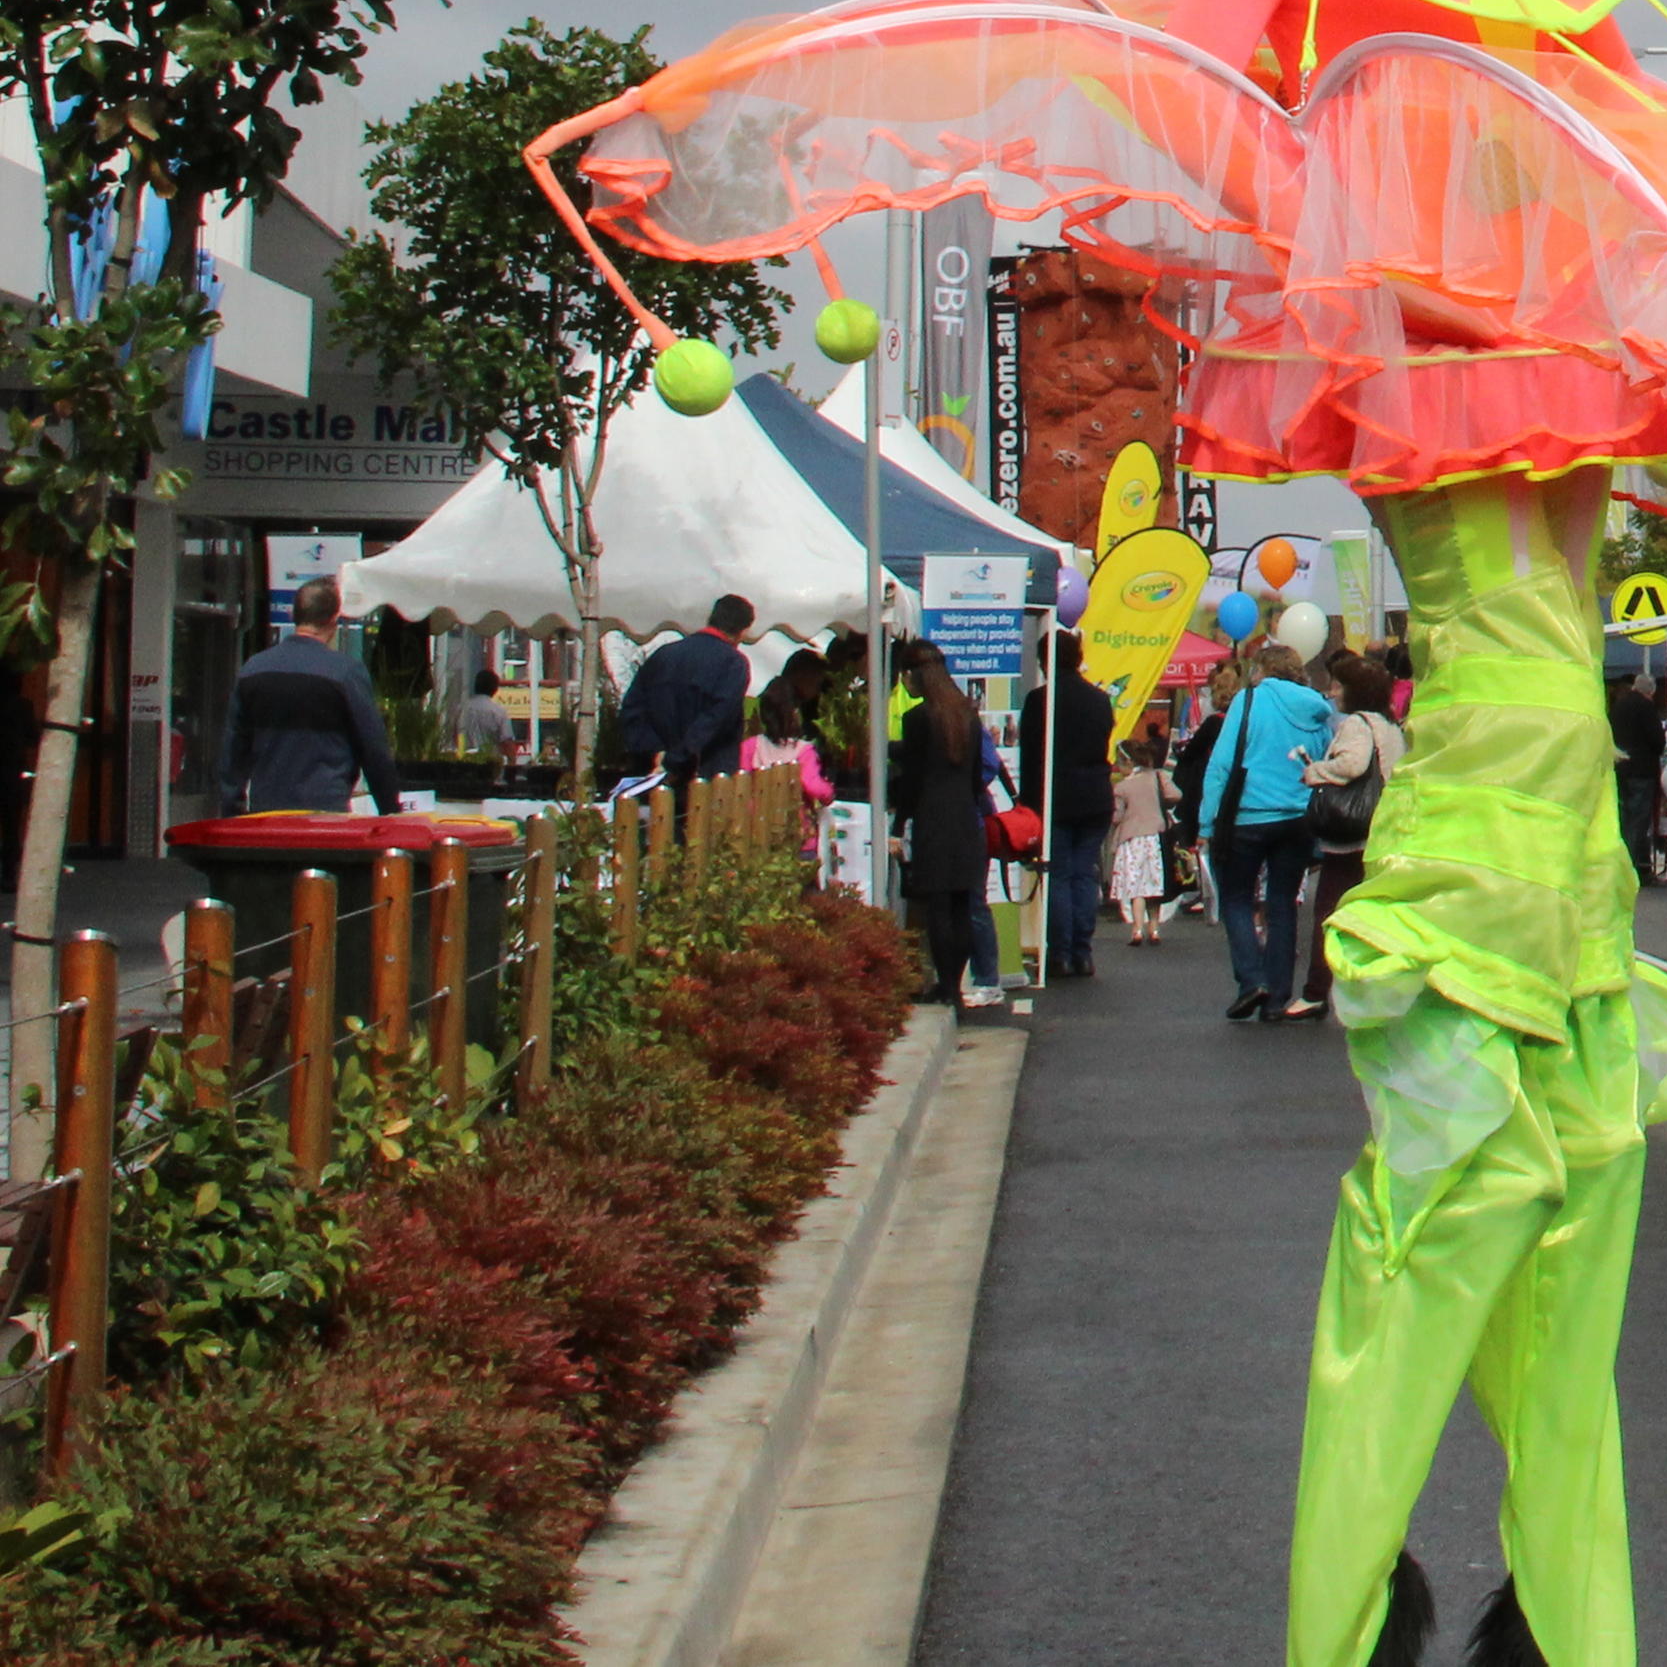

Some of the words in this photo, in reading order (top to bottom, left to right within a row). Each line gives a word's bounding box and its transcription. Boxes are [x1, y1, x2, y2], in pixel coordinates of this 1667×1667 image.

[933, 245, 971, 337] OBF
[210, 400, 356, 440] Castle
[204, 450, 353, 474] SHOPPING
[363, 452, 477, 476] CENTRE
